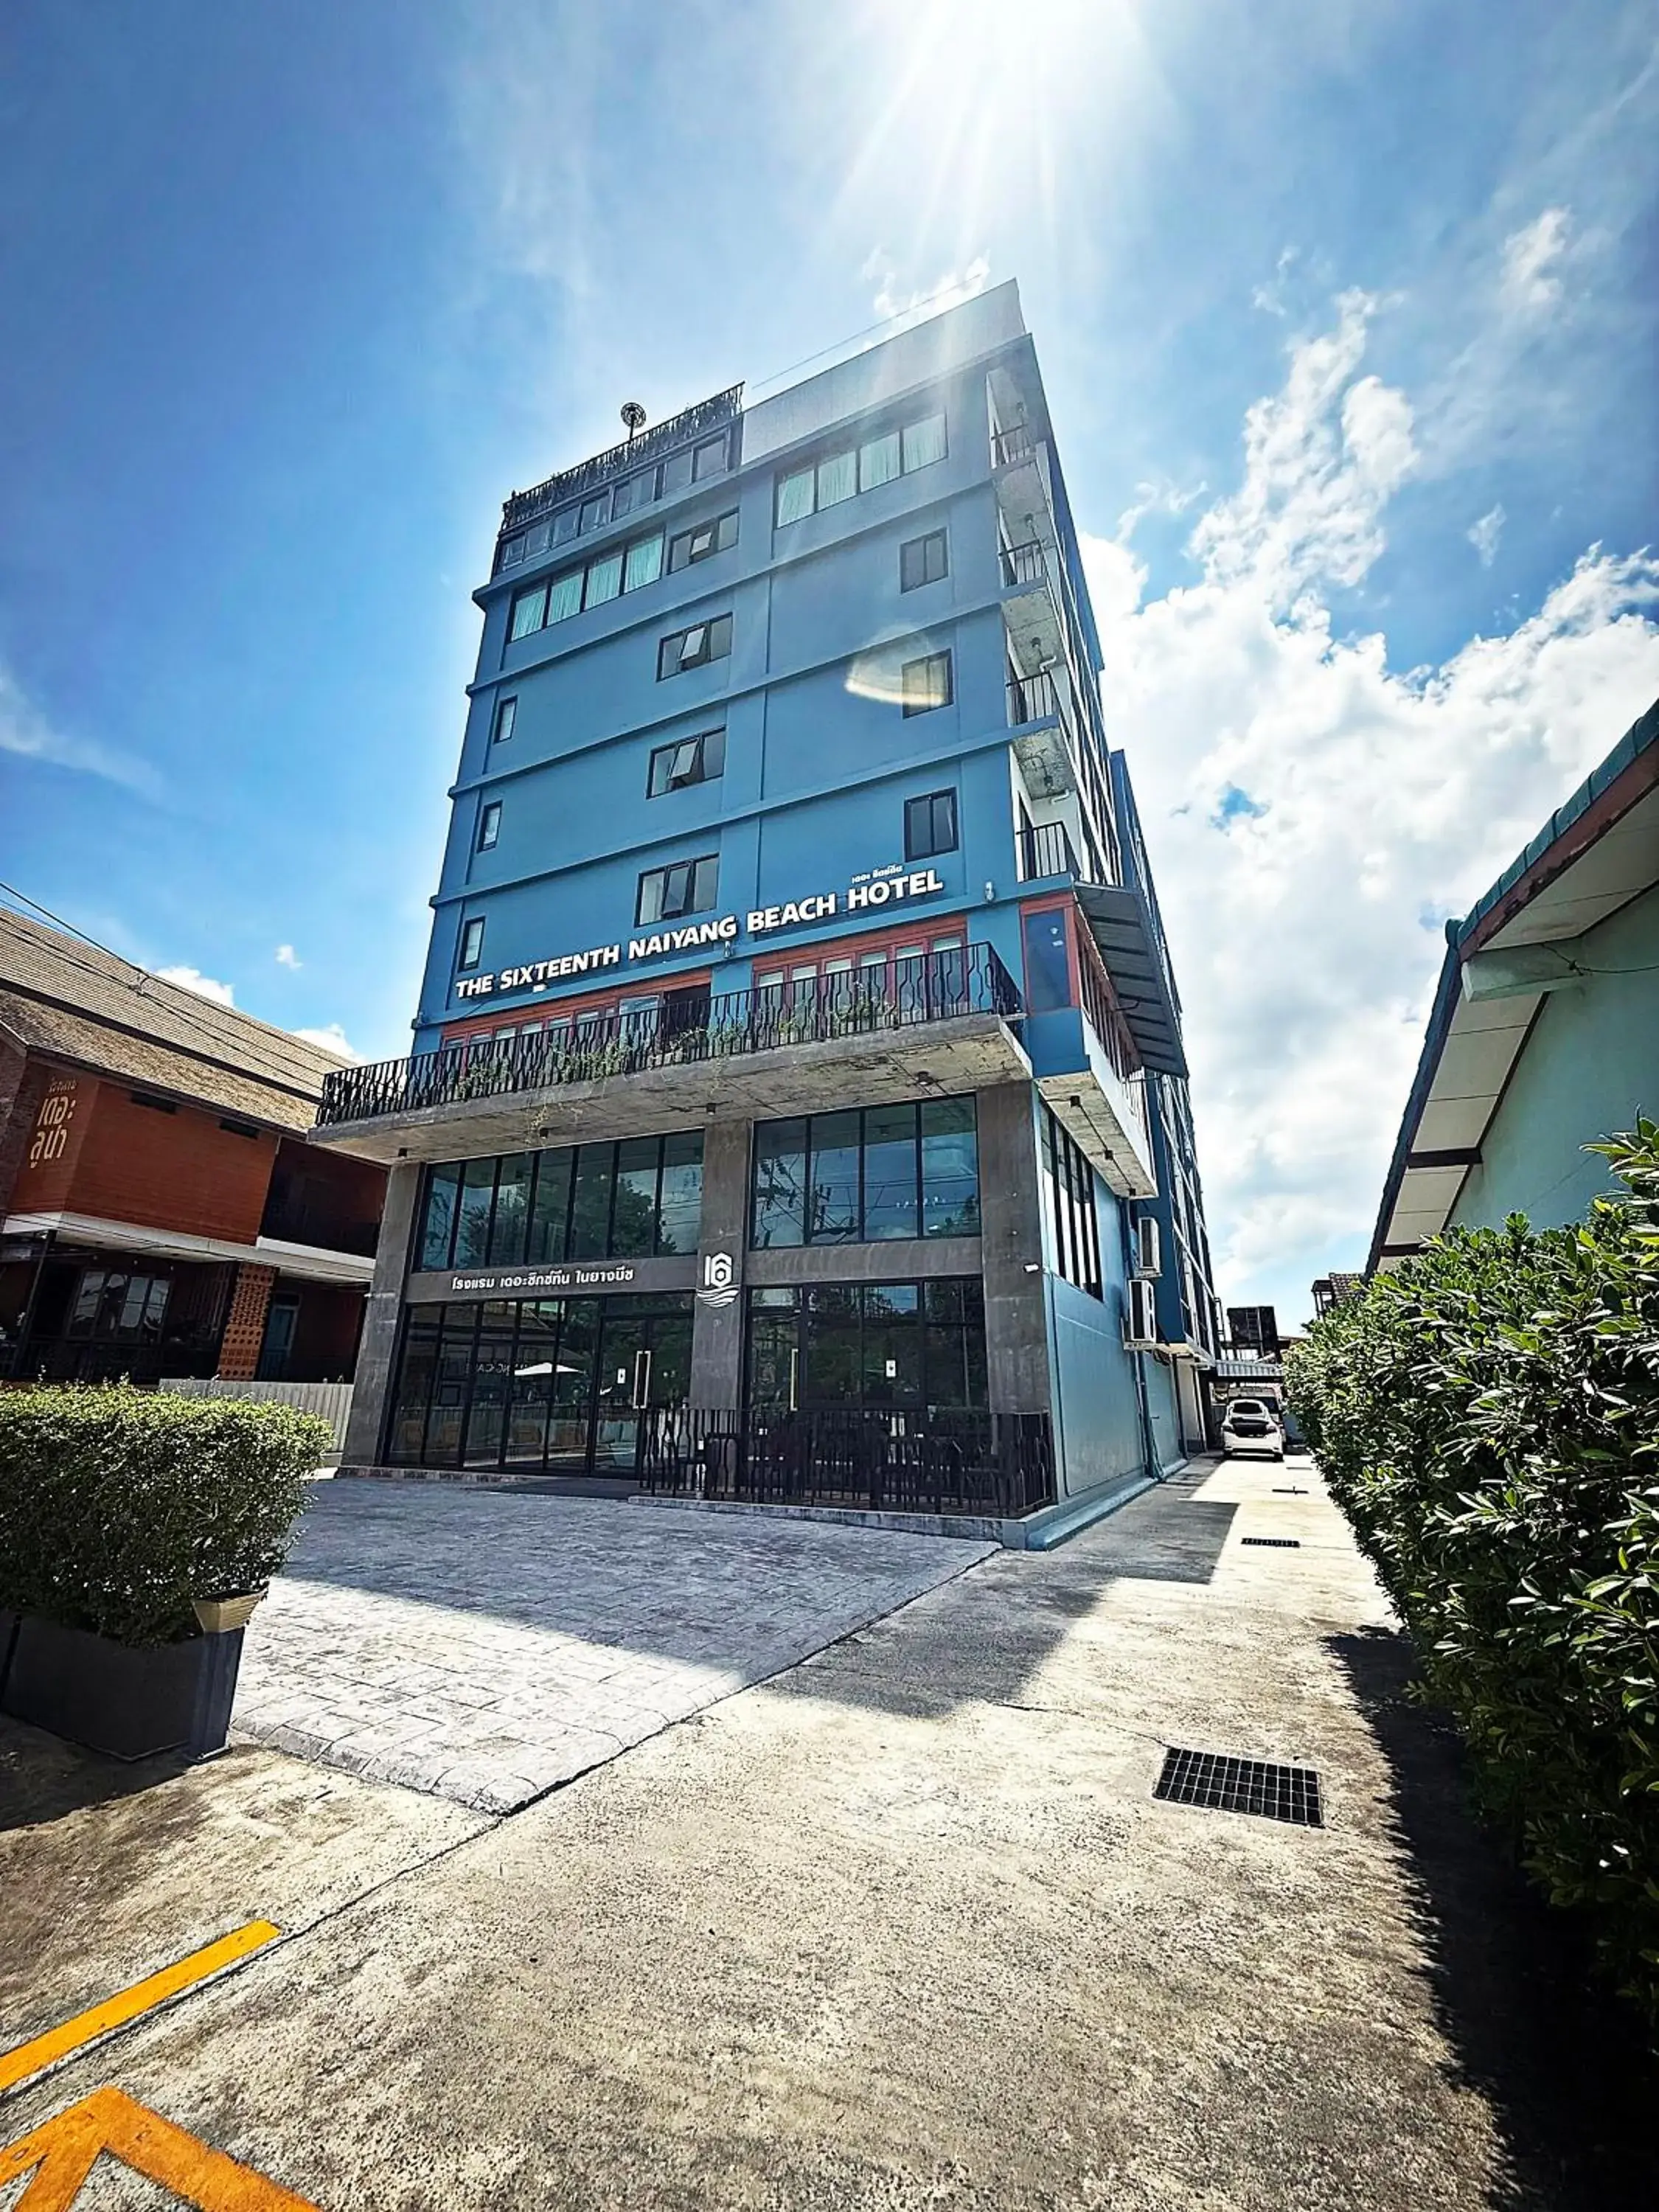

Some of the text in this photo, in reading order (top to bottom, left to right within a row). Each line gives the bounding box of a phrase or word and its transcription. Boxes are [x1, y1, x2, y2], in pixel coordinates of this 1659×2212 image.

[456, 869, 944, 998] THE SIXTEENTH NAIYANG BEACH HOTEL
[452, 1276, 495, 1290] โรงแรม
[704, 1252, 732, 1288] 16
